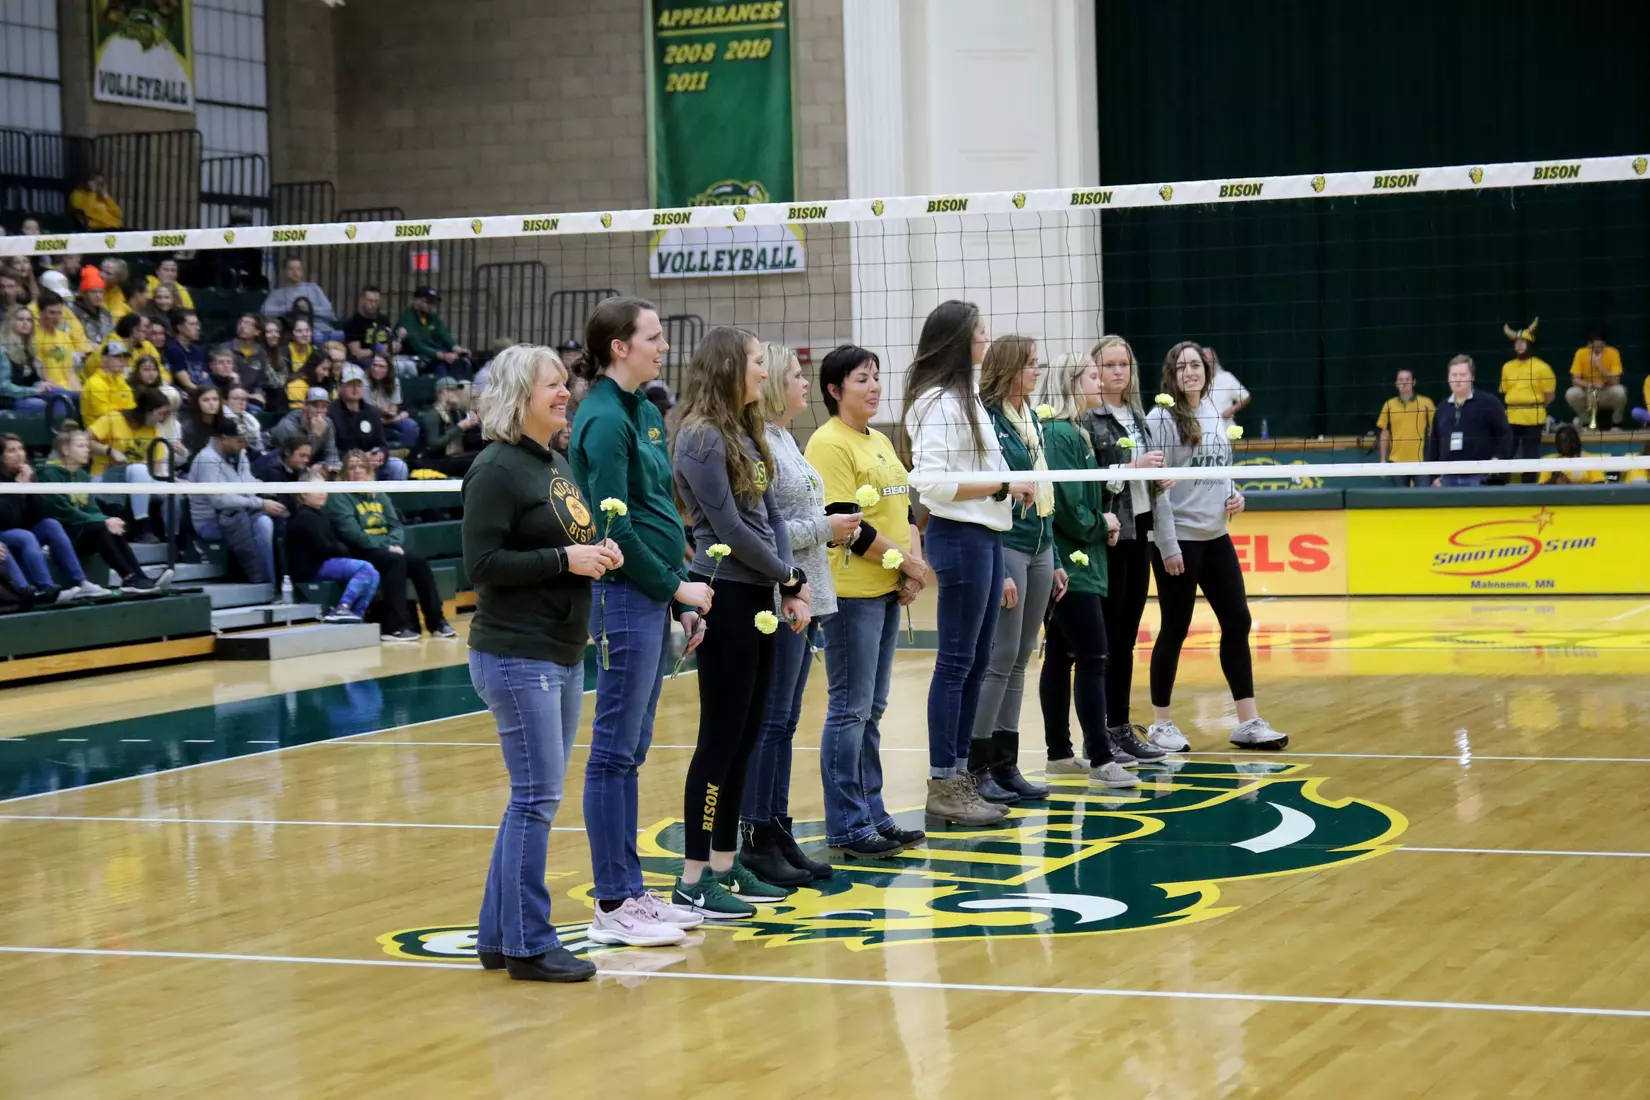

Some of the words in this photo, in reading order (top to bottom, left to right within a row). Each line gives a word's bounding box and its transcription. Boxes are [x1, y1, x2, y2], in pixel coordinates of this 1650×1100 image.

[658, 1, 783, 27] APPEARANCES
[664, 42, 717, 64] 2008
[724, 37, 772, 60] 2010
[98, 69, 189, 105] VOLLEYBALL
[665, 71, 709, 92] 2011
[1532, 164, 1581, 180] BISON
[1372, 174, 1420, 189] BISON
[1218, 183, 1264, 197] BISON
[926, 198, 969, 213] BISON
[1070, 191, 1114, 206] BISON
[652, 212, 692, 225] BISON
[787, 206, 828, 220] BISON
[395, 224, 431, 237] BISON
[522, 218, 559, 232] BISON
[151, 234, 187, 247] BISON
[272, 230, 307, 242] BISON
[34, 239, 68, 251] BISON
[658, 246, 797, 273] VOLLEYBALL
[553, 481, 580, 501] NDSU
[1432, 544, 1530, 566] SHOOTING
[1544, 536, 1597, 552] STAR
[1535, 579, 1555, 588] MN
[702, 782, 719, 832] BISON
